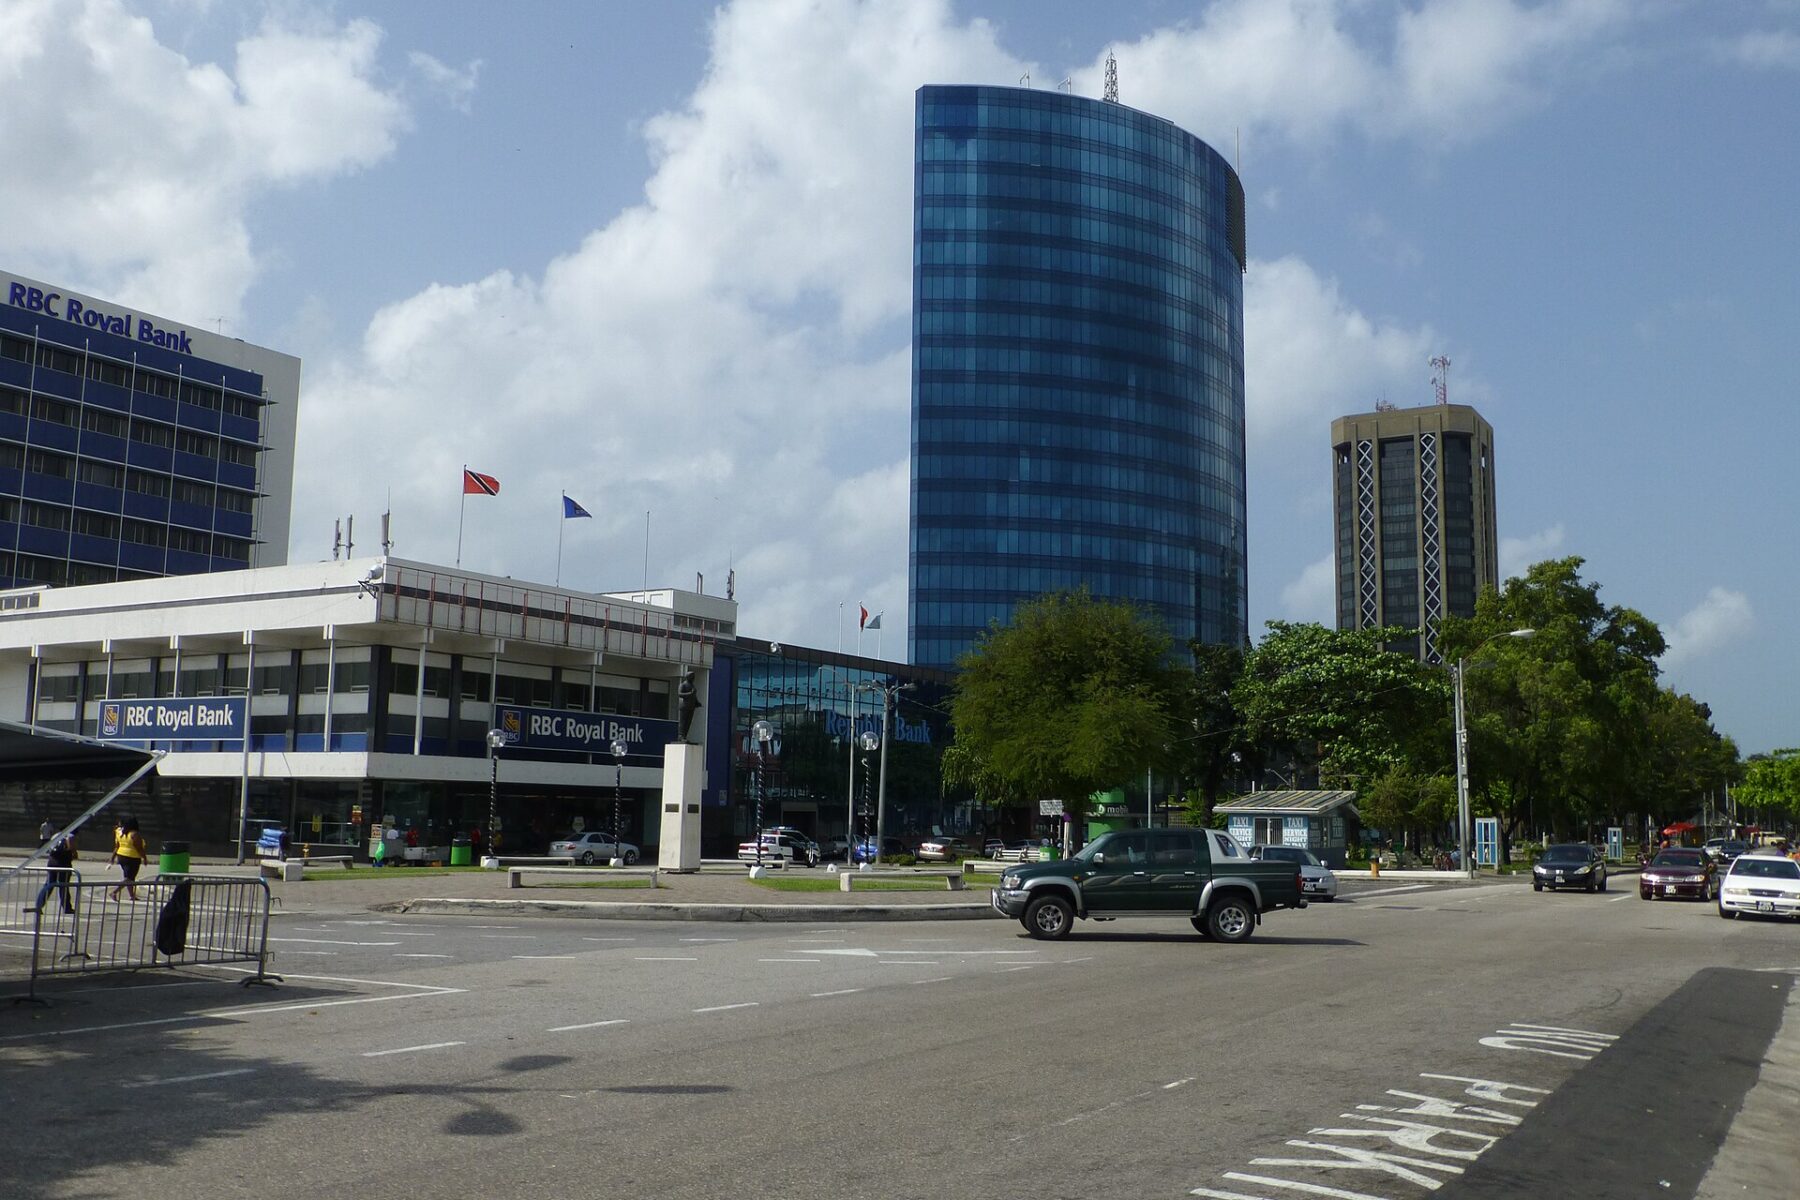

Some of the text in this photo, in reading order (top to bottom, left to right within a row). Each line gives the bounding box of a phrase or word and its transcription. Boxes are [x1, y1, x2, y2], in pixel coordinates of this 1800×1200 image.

[9, 281, 192, 354] RBC Royal Bank
[126, 704, 233, 731] RBC Royal Bank
[104, 725, 116, 733] RBC
[530, 714, 644, 744] RBC Royal Bank
[823, 709, 932, 744] Republi Bank
[503, 732, 519, 741] RBC
[1232, 816, 1249, 827] TAXI
[1287, 817, 1304, 828] TAXI
[1283, 829, 1308, 837] SERVICE
